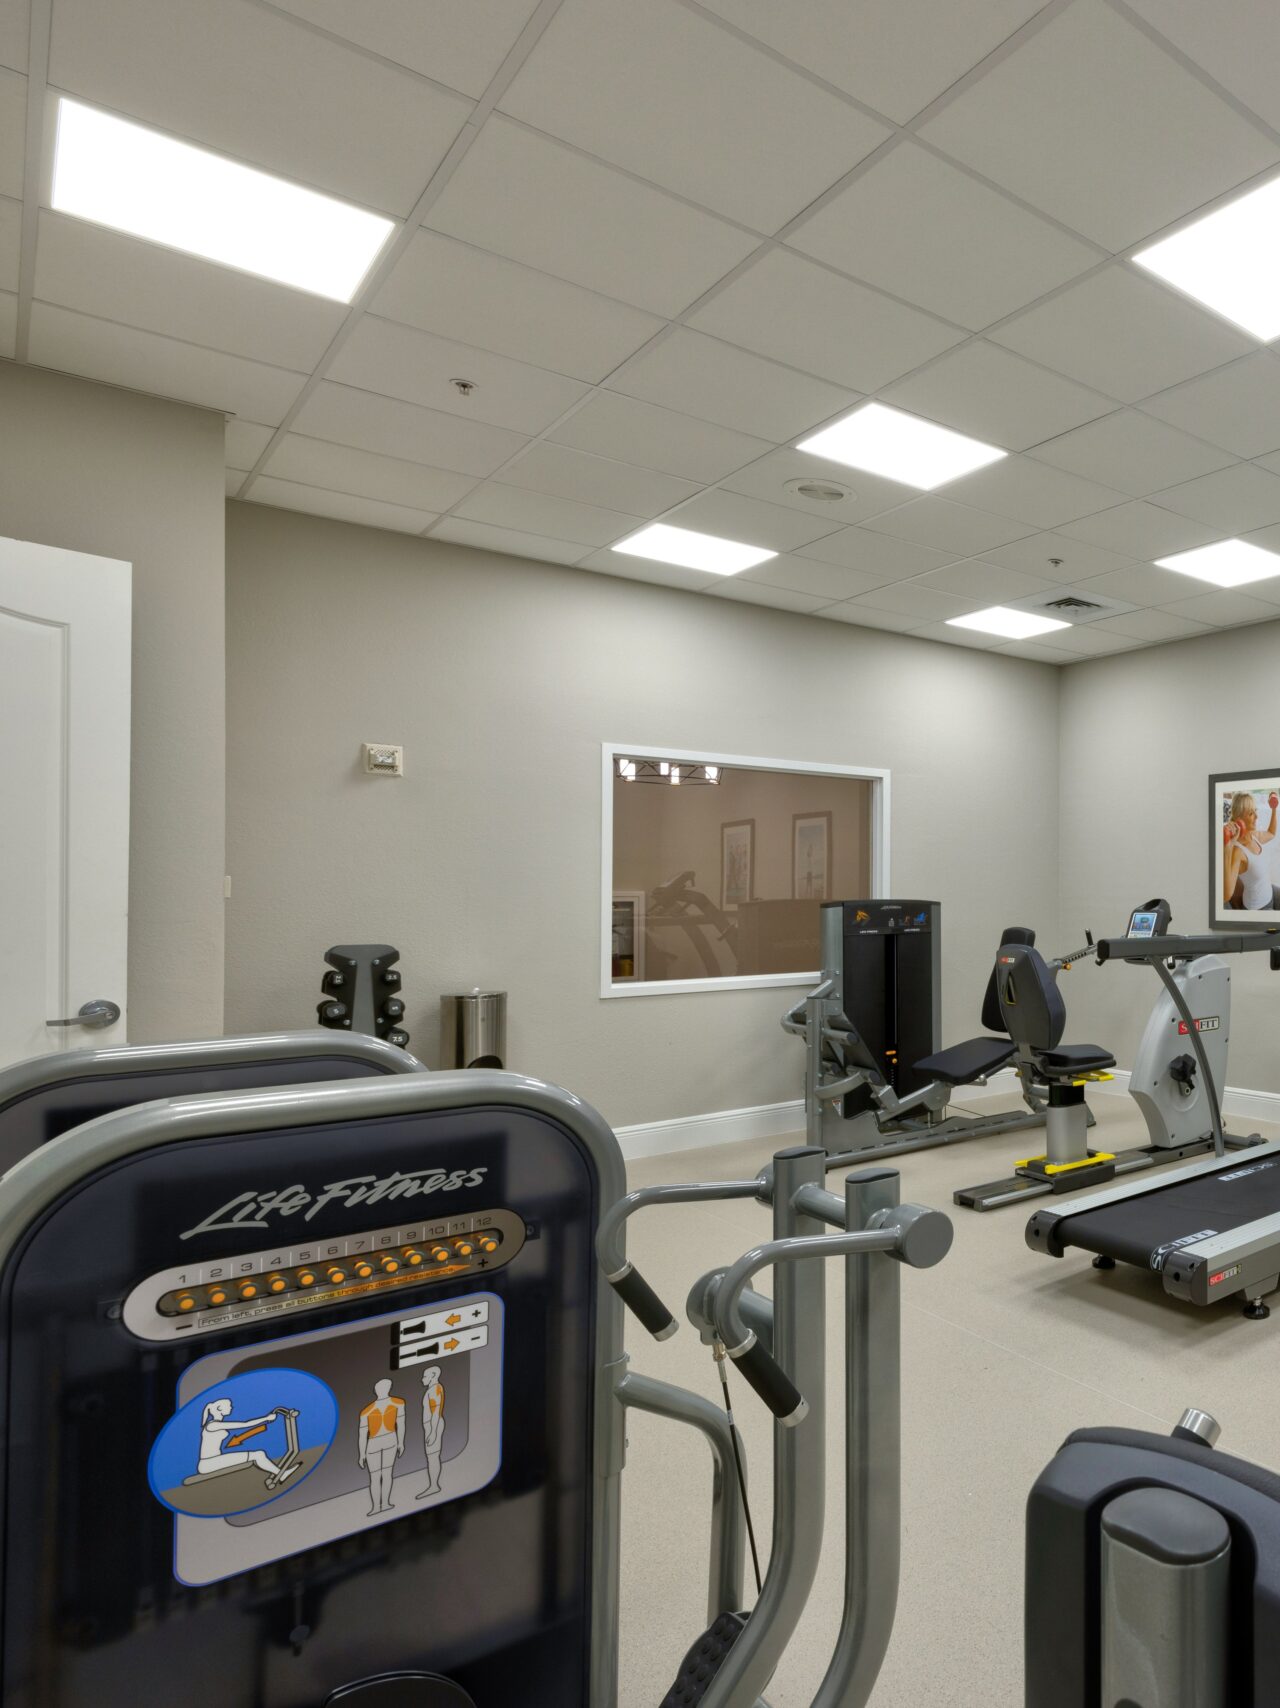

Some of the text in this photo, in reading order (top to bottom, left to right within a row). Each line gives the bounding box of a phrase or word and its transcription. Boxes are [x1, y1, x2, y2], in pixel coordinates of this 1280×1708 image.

[1181, 1019, 1218, 1031] SIFIT
[179, 1167, 488, 1241] Life Fitness
[179, 1217, 492, 1284] 1 2 3 4 5 6 7 8 9 10 11 12
[201, 1314, 230, 1326] From
[254, 1304, 283, 1316] press
[297, 1292, 335, 1305] buttons
[337, 1283, 373, 1296] through
[375, 1274, 407, 1286] desired
